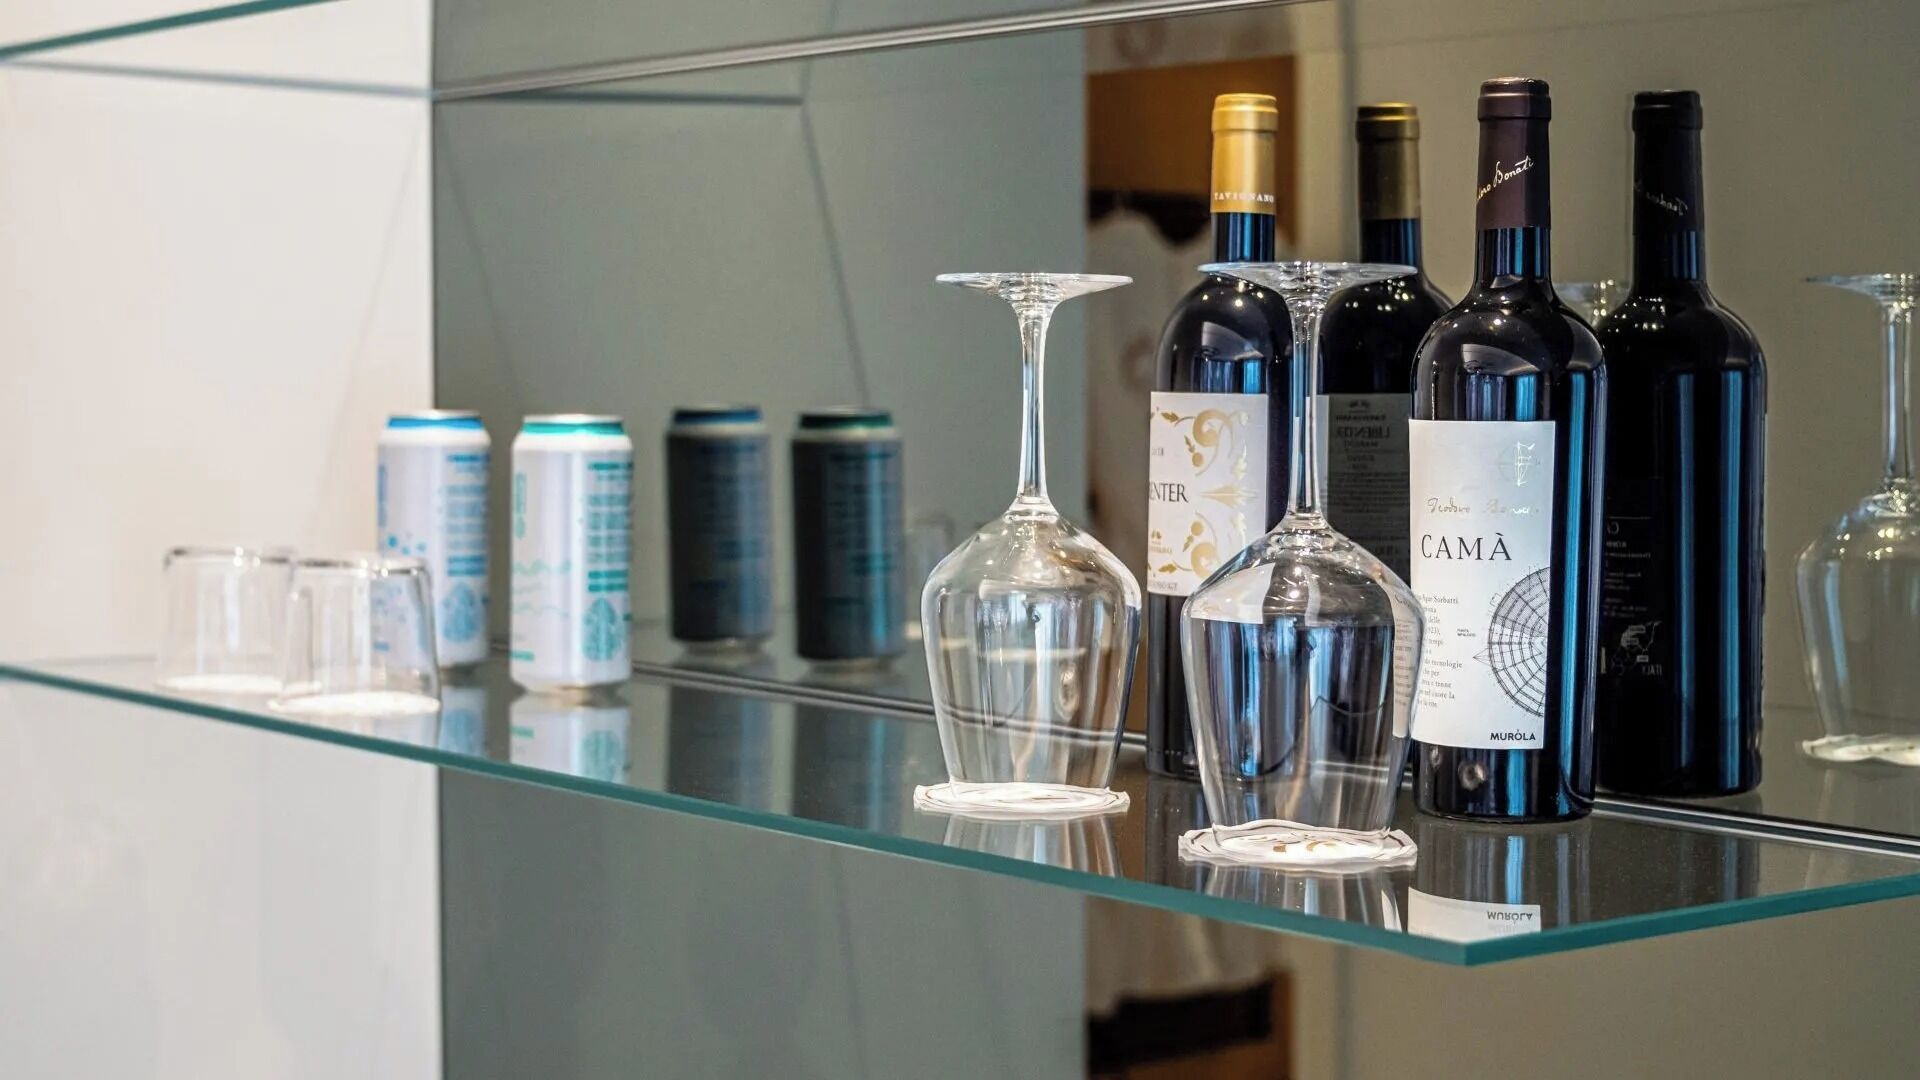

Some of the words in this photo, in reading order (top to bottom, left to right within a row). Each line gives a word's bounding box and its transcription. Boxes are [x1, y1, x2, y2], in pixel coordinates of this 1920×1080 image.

[1493, 155, 1534, 187] Bonati
[1421, 532, 1513, 561] CAMÀ
[1490, 729, 1536, 741] MURÒLA
